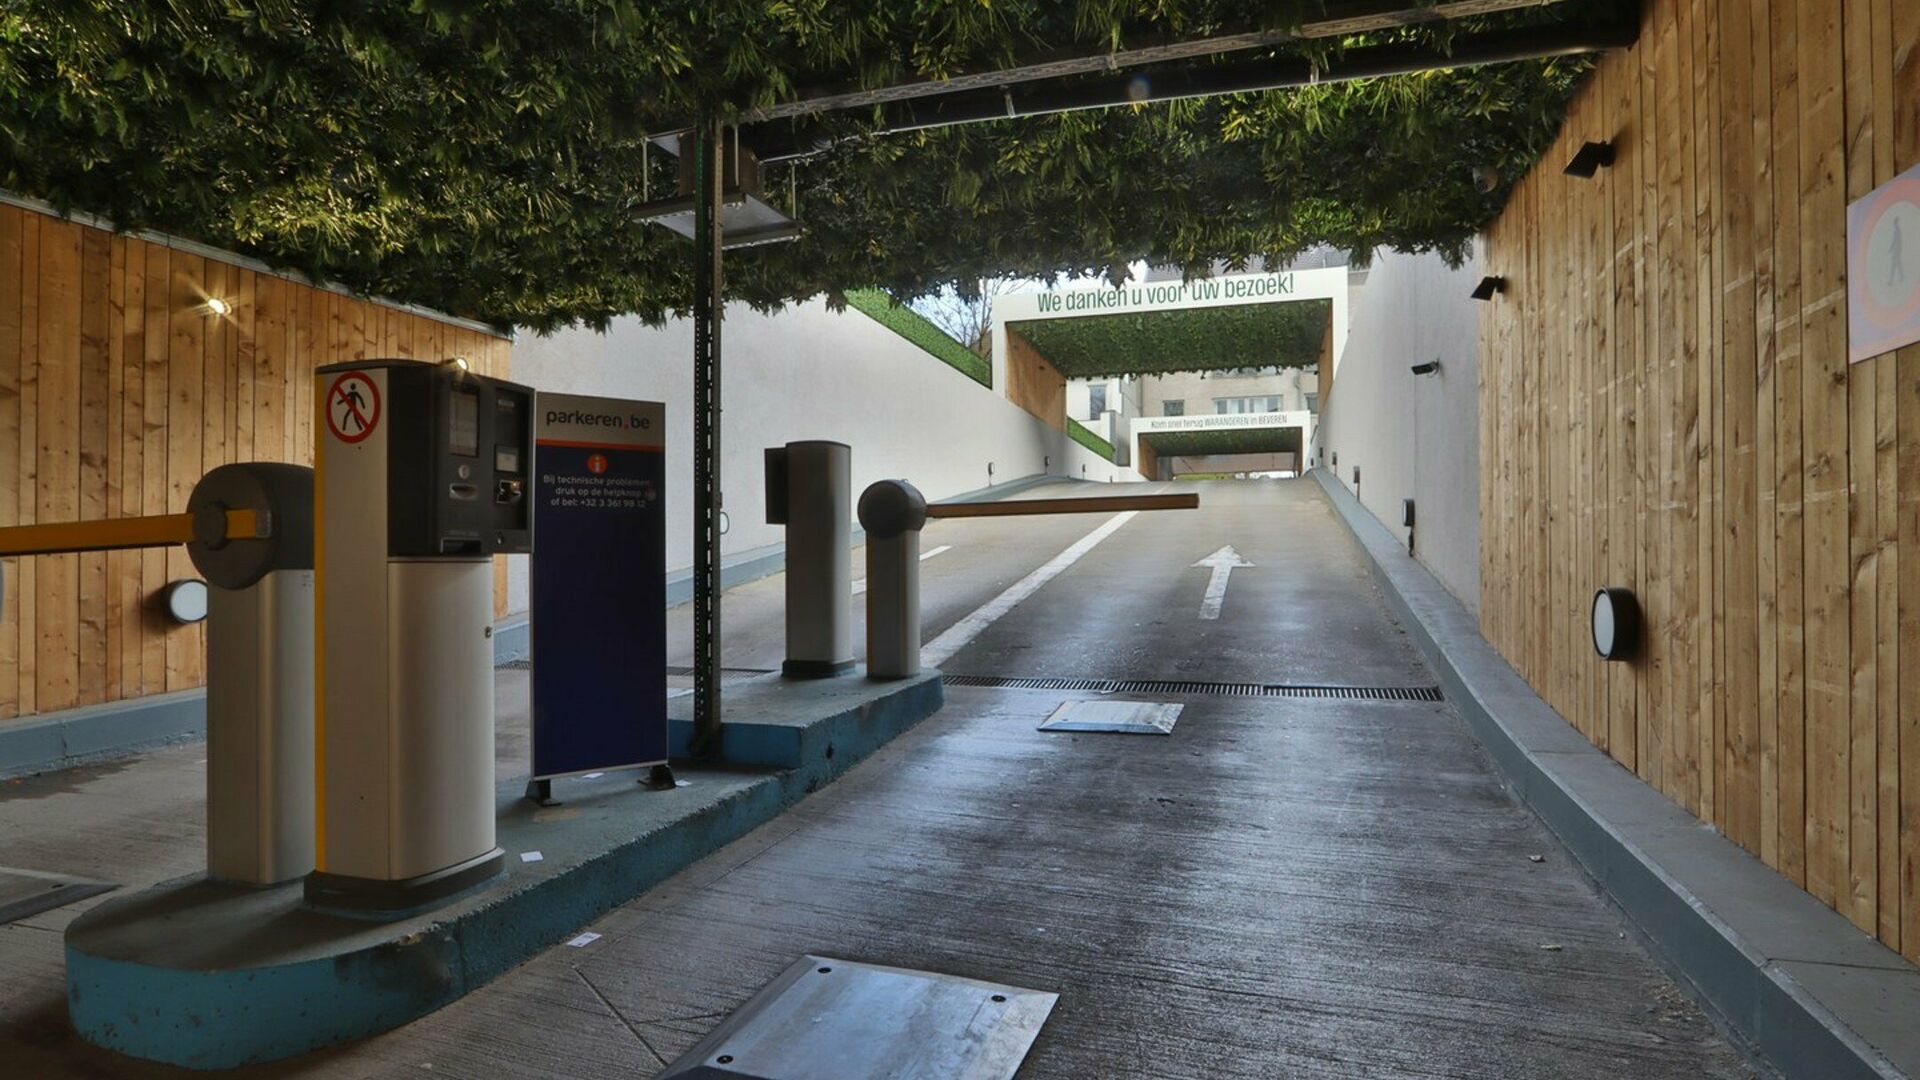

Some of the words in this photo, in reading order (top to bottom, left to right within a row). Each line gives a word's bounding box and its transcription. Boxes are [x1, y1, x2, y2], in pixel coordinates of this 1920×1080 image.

[1037, 292, 1062, 312] We
[1066, 290, 1127, 310] danken
[1132, 289, 1142, 305] u
[1146, 285, 1188, 304] voor
[1191, 280, 1220, 301] uw
[1224, 272, 1294, 298] bezoek!
[545, 410, 650, 429] parkeren.be
[1258, 415, 1287, 424] BEVEREN
[543, 474, 555, 485] Bij
[557, 475, 604, 485] technische
[555, 487, 575, 495] druk
[577, 488, 589, 497] op
[591, 488, 602, 496] de
[551, 498, 560, 506] of
[562, 498, 577, 506] bel:
[580, 499, 597, 507] +32
[599, 499, 605, 507] 3
